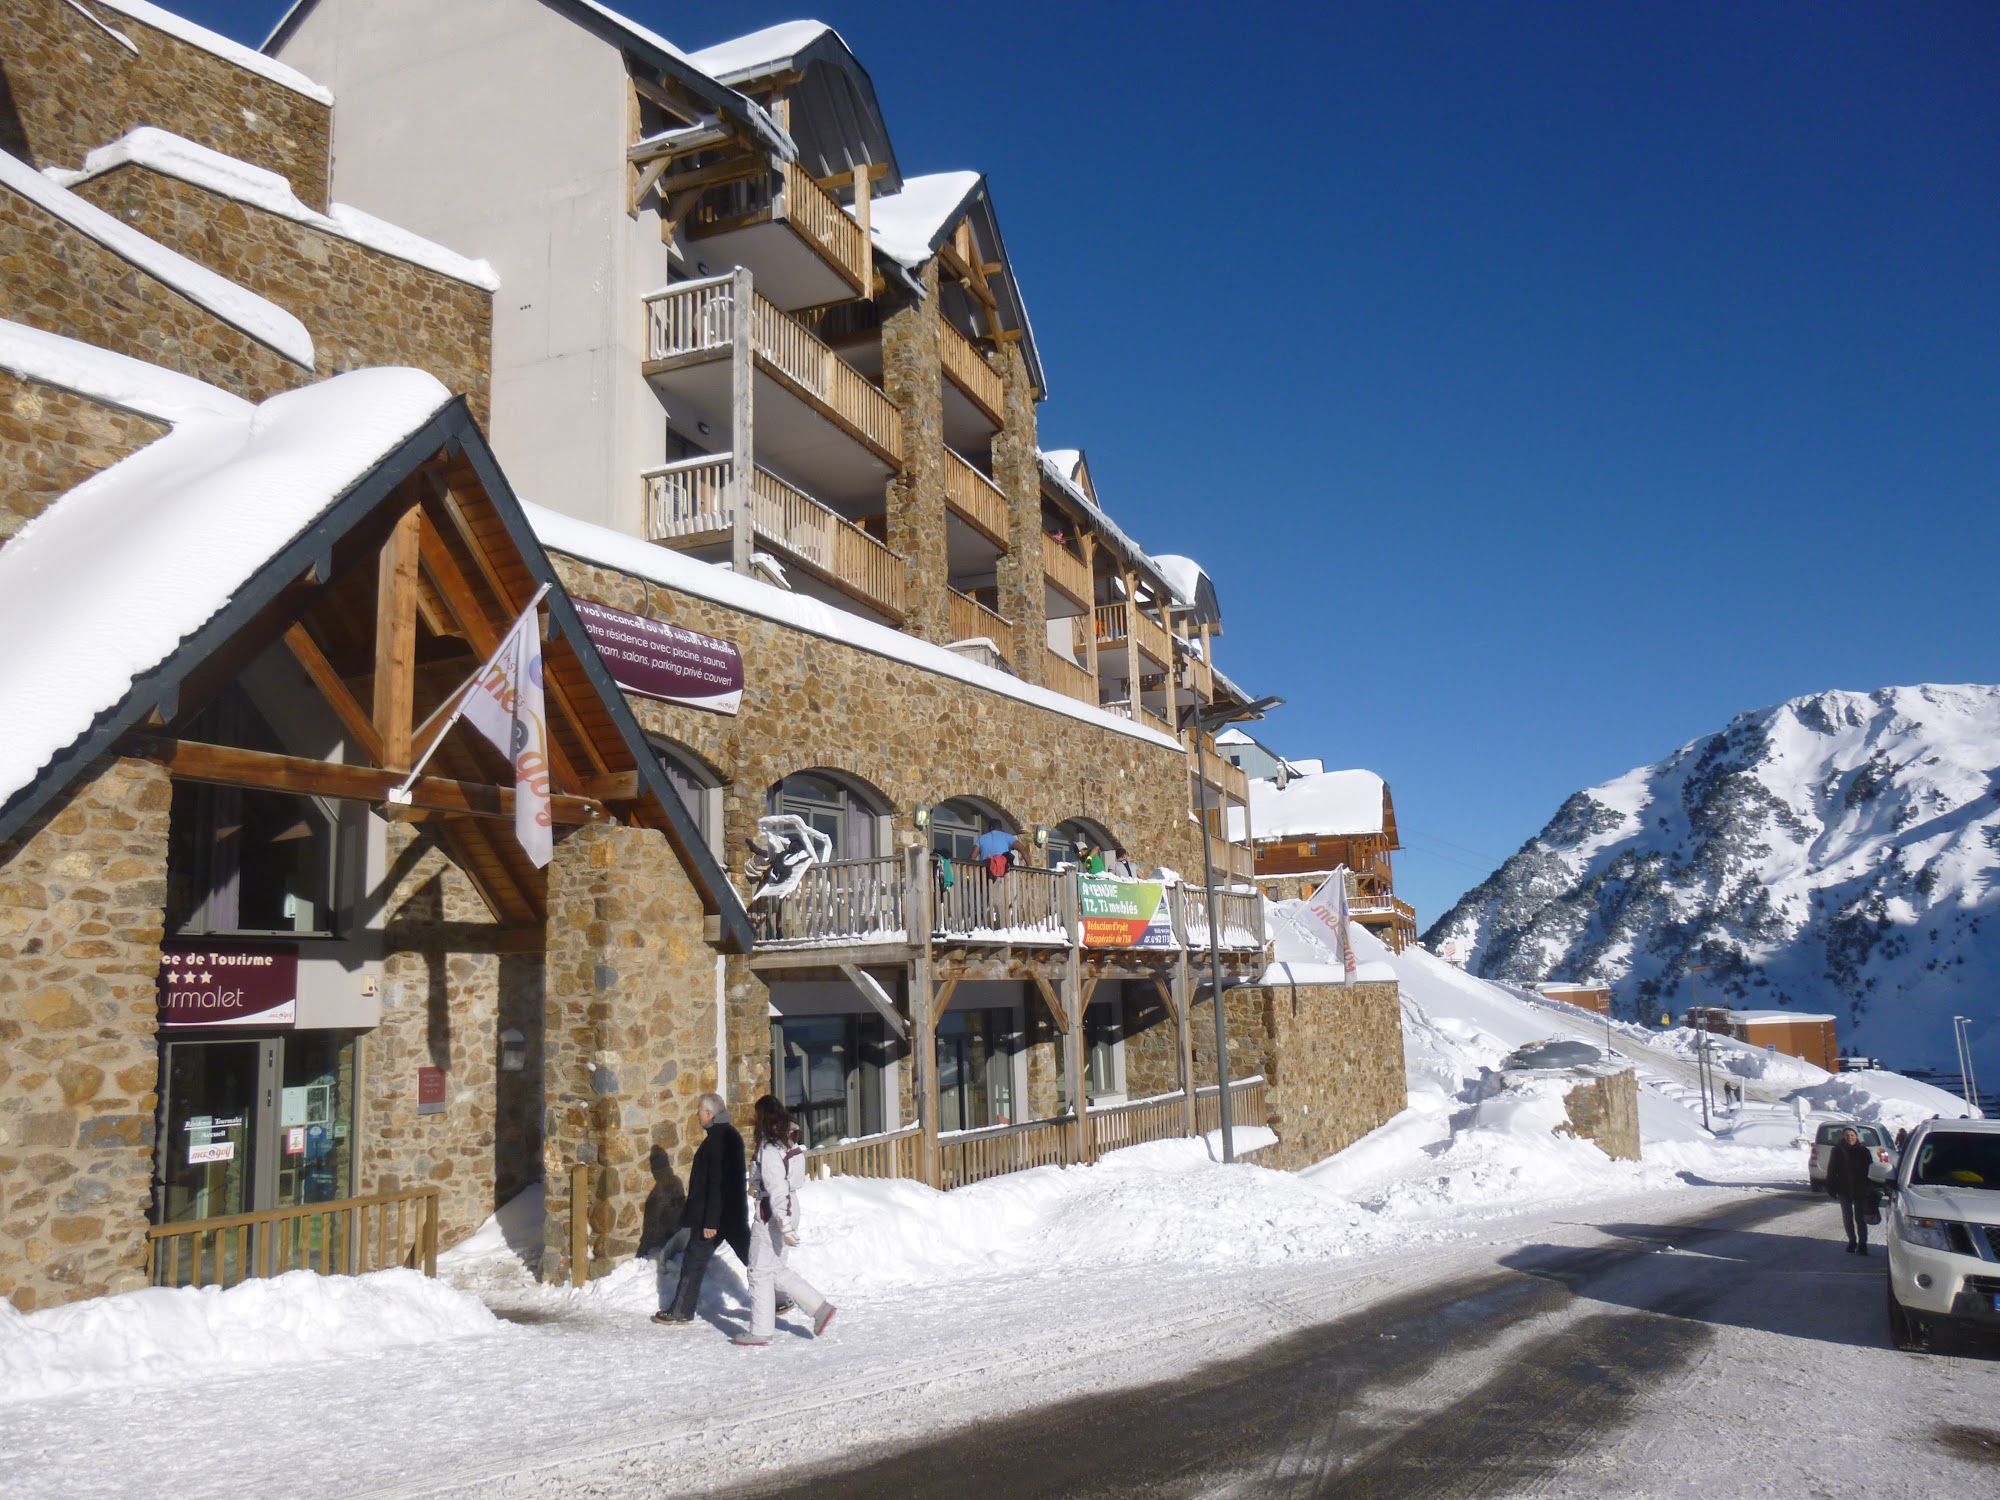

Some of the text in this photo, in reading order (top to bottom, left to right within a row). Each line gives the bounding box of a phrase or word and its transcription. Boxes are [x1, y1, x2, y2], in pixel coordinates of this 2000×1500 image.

[583, 606, 601, 617] vos
[601, 610, 645, 629] vacances
[606, 628, 649, 648] résidence
[650, 642, 672, 654] avec
[672, 646, 702, 663] piscine,
[703, 656, 728, 670] sauna,
[622, 650, 650, 666] salons,
[651, 657, 682, 676] parking
[682, 666, 703, 681] privé
[703, 671, 733, 686] couvert
[186, 953, 205, 965] de
[209, 952, 273, 966] Tourisme
